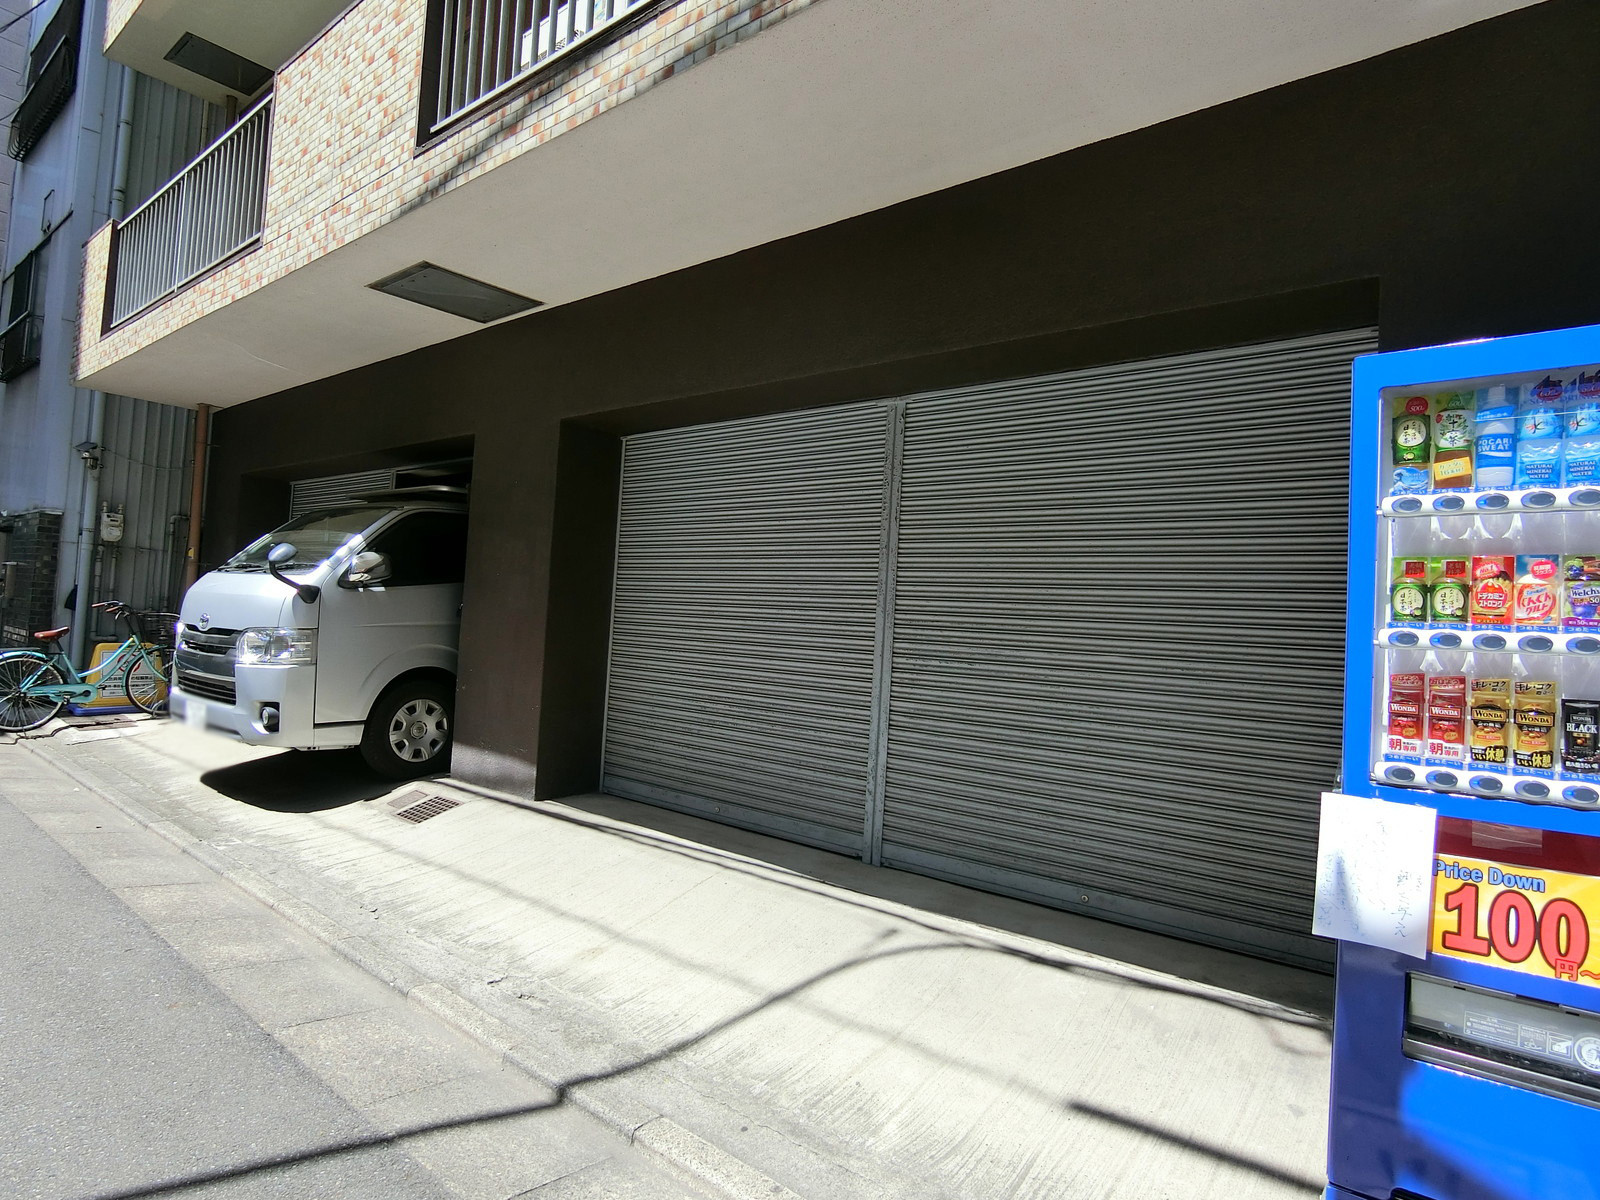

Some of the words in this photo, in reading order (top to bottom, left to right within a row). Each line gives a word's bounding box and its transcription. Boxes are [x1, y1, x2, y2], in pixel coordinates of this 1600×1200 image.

[1478, 438, 1512, 446] POCARI
[1478, 444, 1509, 452] SWEAT
[1390, 703, 1416, 712] WONDA
[1431, 707, 1458, 716] WONDA
[1475, 710, 1503, 719] WONDA
[1520, 714, 1549, 723] WONDA
[1566, 722, 1598, 734] BLACK
[1434, 859, 1483, 883] Price
[1488, 867, 1545, 893] Down
[1442, 883, 1589, 970] 100
